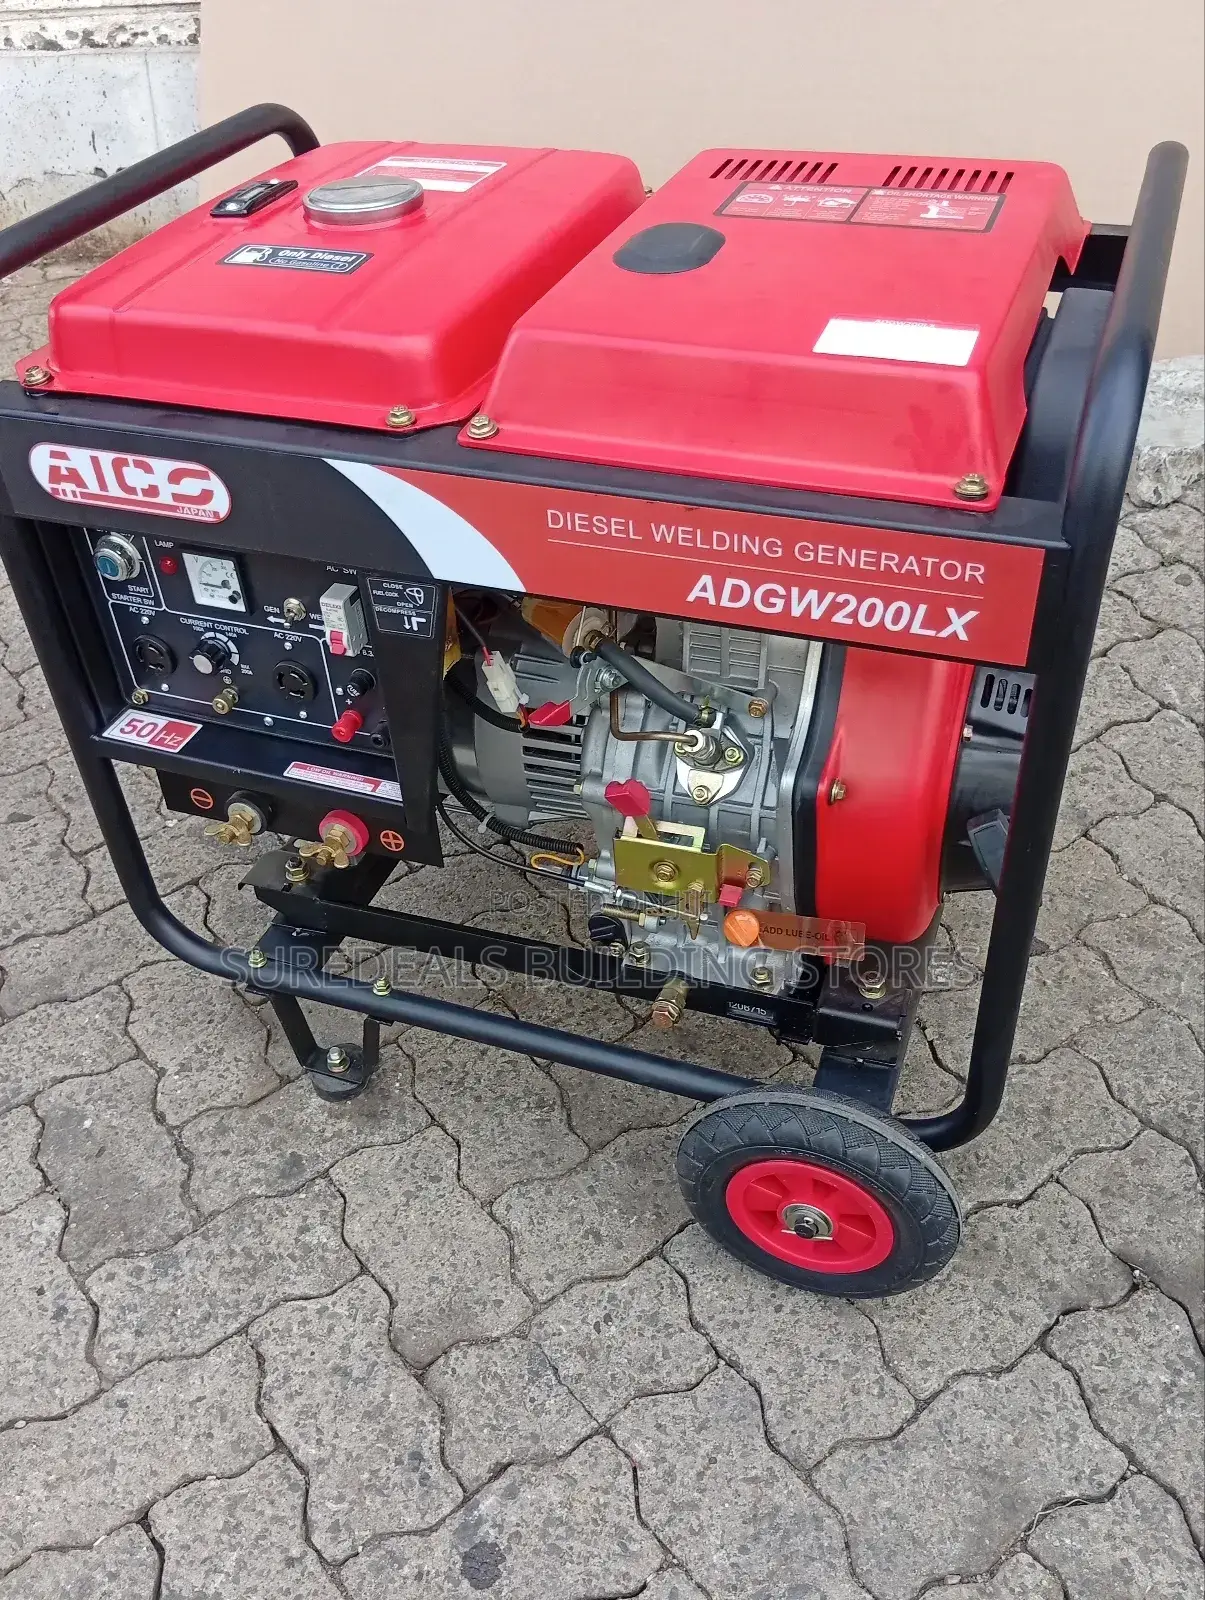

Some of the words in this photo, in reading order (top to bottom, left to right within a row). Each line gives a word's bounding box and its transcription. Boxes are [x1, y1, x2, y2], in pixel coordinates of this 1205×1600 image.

[784, 186, 852, 194] ATTENTION
[903, 191, 952, 200] SHORTAGE
[954, 193, 999, 202] WARNING
[278, 249, 311, 259] Only
[310, 252, 357, 262] Diesel
[289, 259, 330, 269] Gasoline
[48, 449, 214, 506] AICS
[176, 505, 215, 519] JAPAN
[154, 540, 174, 549] LAMP
[547, 509, 642, 540] DIESEL
[651, 523, 783, 558] WELDING
[794, 541, 985, 585] GENERATOR
[128, 585, 149, 594] START
[111, 592, 143, 604] STARTER
[129, 606, 139, 614] AC
[263, 605, 280, 614] GEN
[375, 607, 416, 616] DECOMPRESS
[686, 573, 981, 642] ADGW200LX
[180, 617, 213, 629] CURRENT
[214, 623, 249, 635] CONTROL
[273, 631, 285, 639] AC
[119, 717, 158, 739] 50
[155, 730, 184, 746] Hz
[763, 926, 783, 936] ADD
